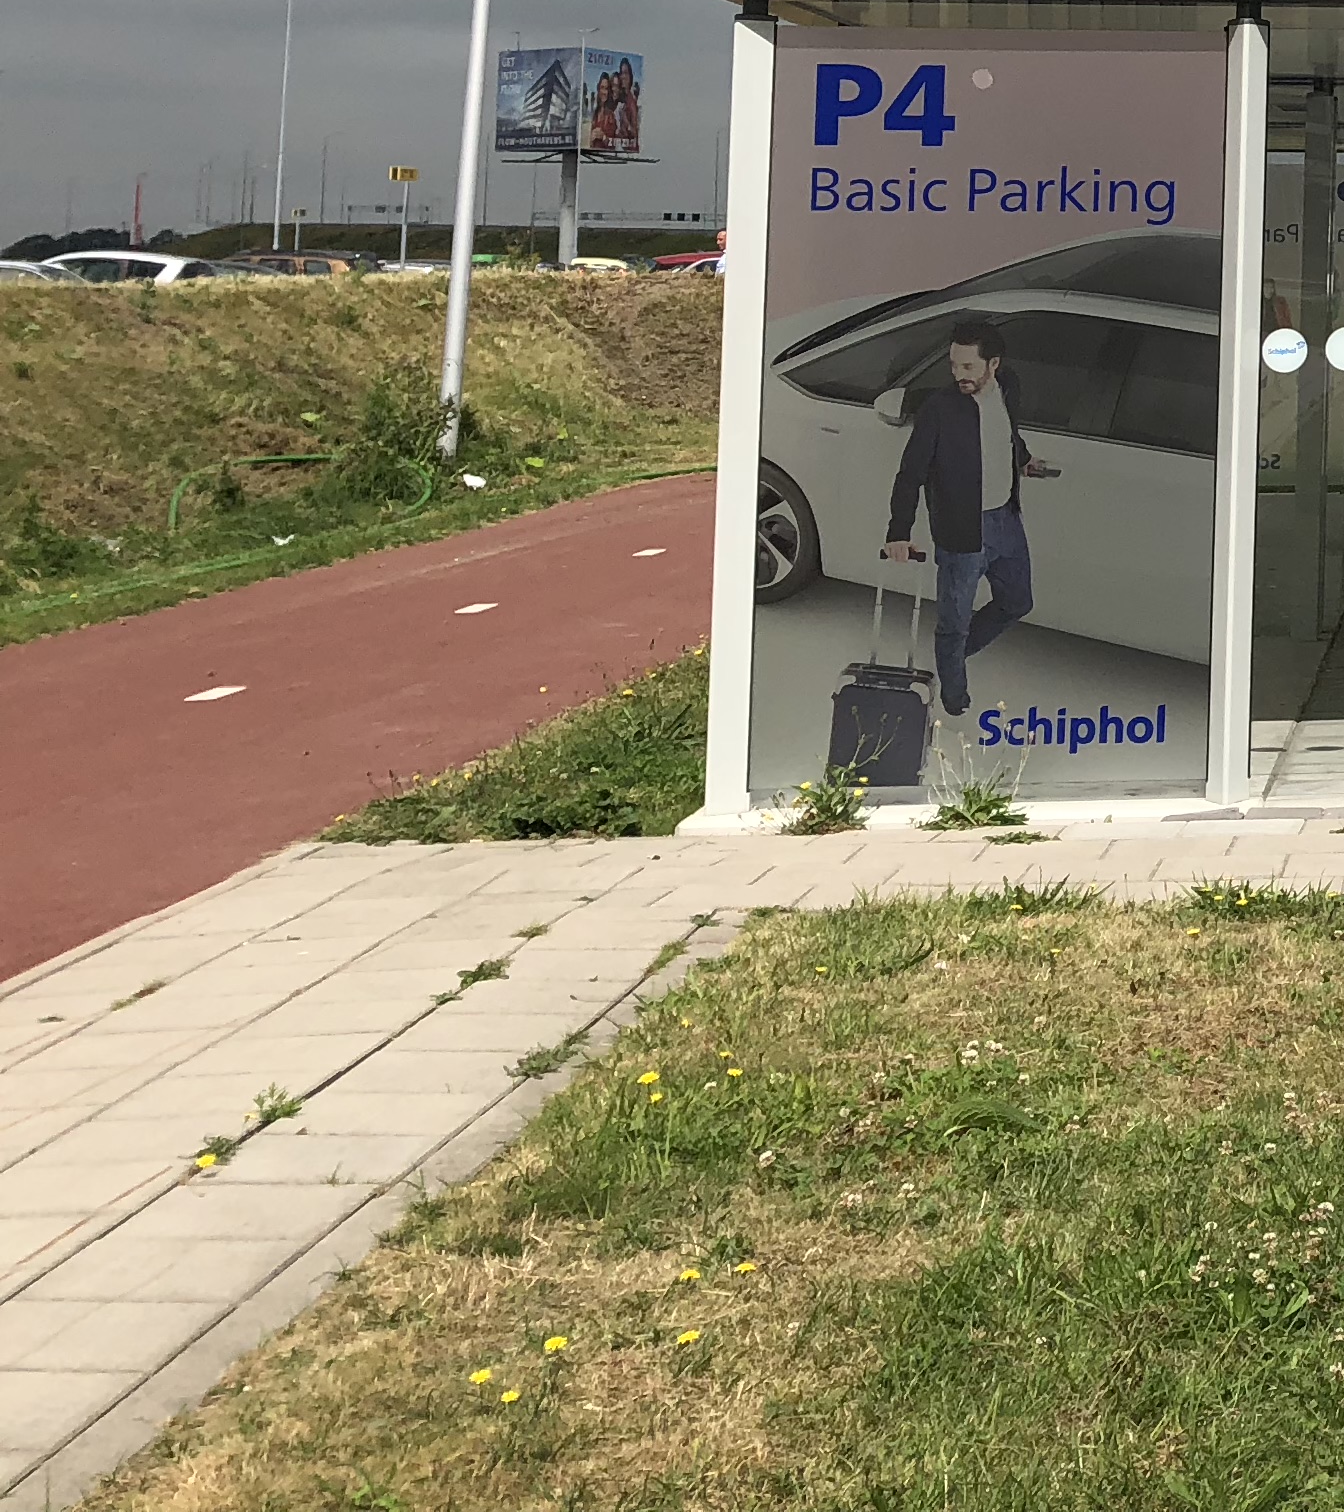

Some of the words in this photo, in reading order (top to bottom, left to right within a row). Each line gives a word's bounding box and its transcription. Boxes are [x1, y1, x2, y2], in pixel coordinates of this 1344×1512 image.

[813, 63, 956, 147] P4
[810, 167, 948, 212] Basic
[967, 167, 1177, 225] Parking
[978, 704, 1167, 755] Schiphol
